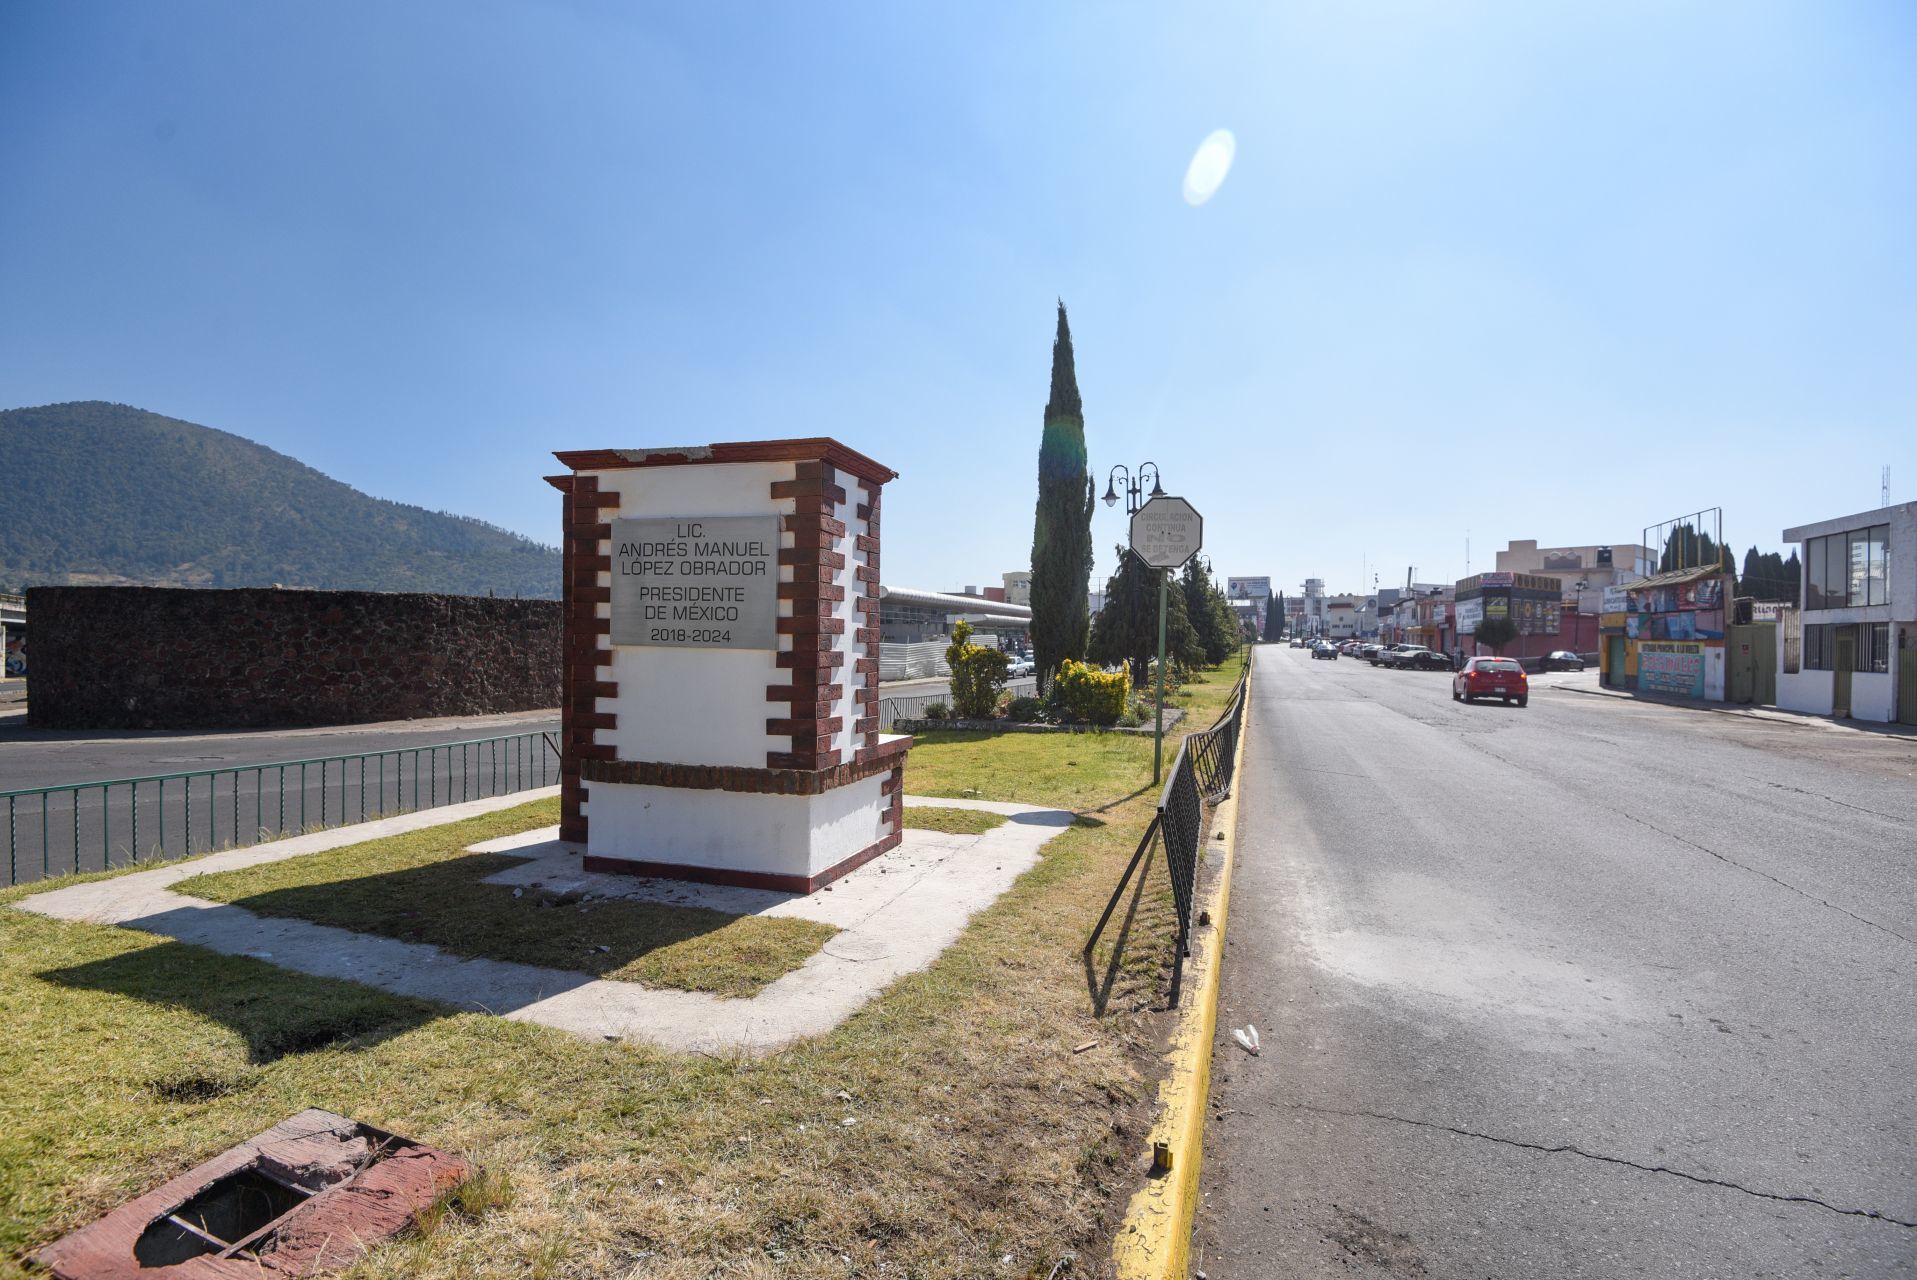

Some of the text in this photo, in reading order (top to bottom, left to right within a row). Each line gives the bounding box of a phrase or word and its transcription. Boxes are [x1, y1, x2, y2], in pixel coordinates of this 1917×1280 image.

[677, 523, 706, 538] LIC.
[618, 538, 770, 557] ANDRÉS MANUEL
[622, 557, 766, 576] LÓPEZ OBRADOR
[640, 586, 745, 602] PRESIDENTE
[645, 602, 738, 621] DE MÉXICO
[651, 628, 732, 643] 2018-2024
